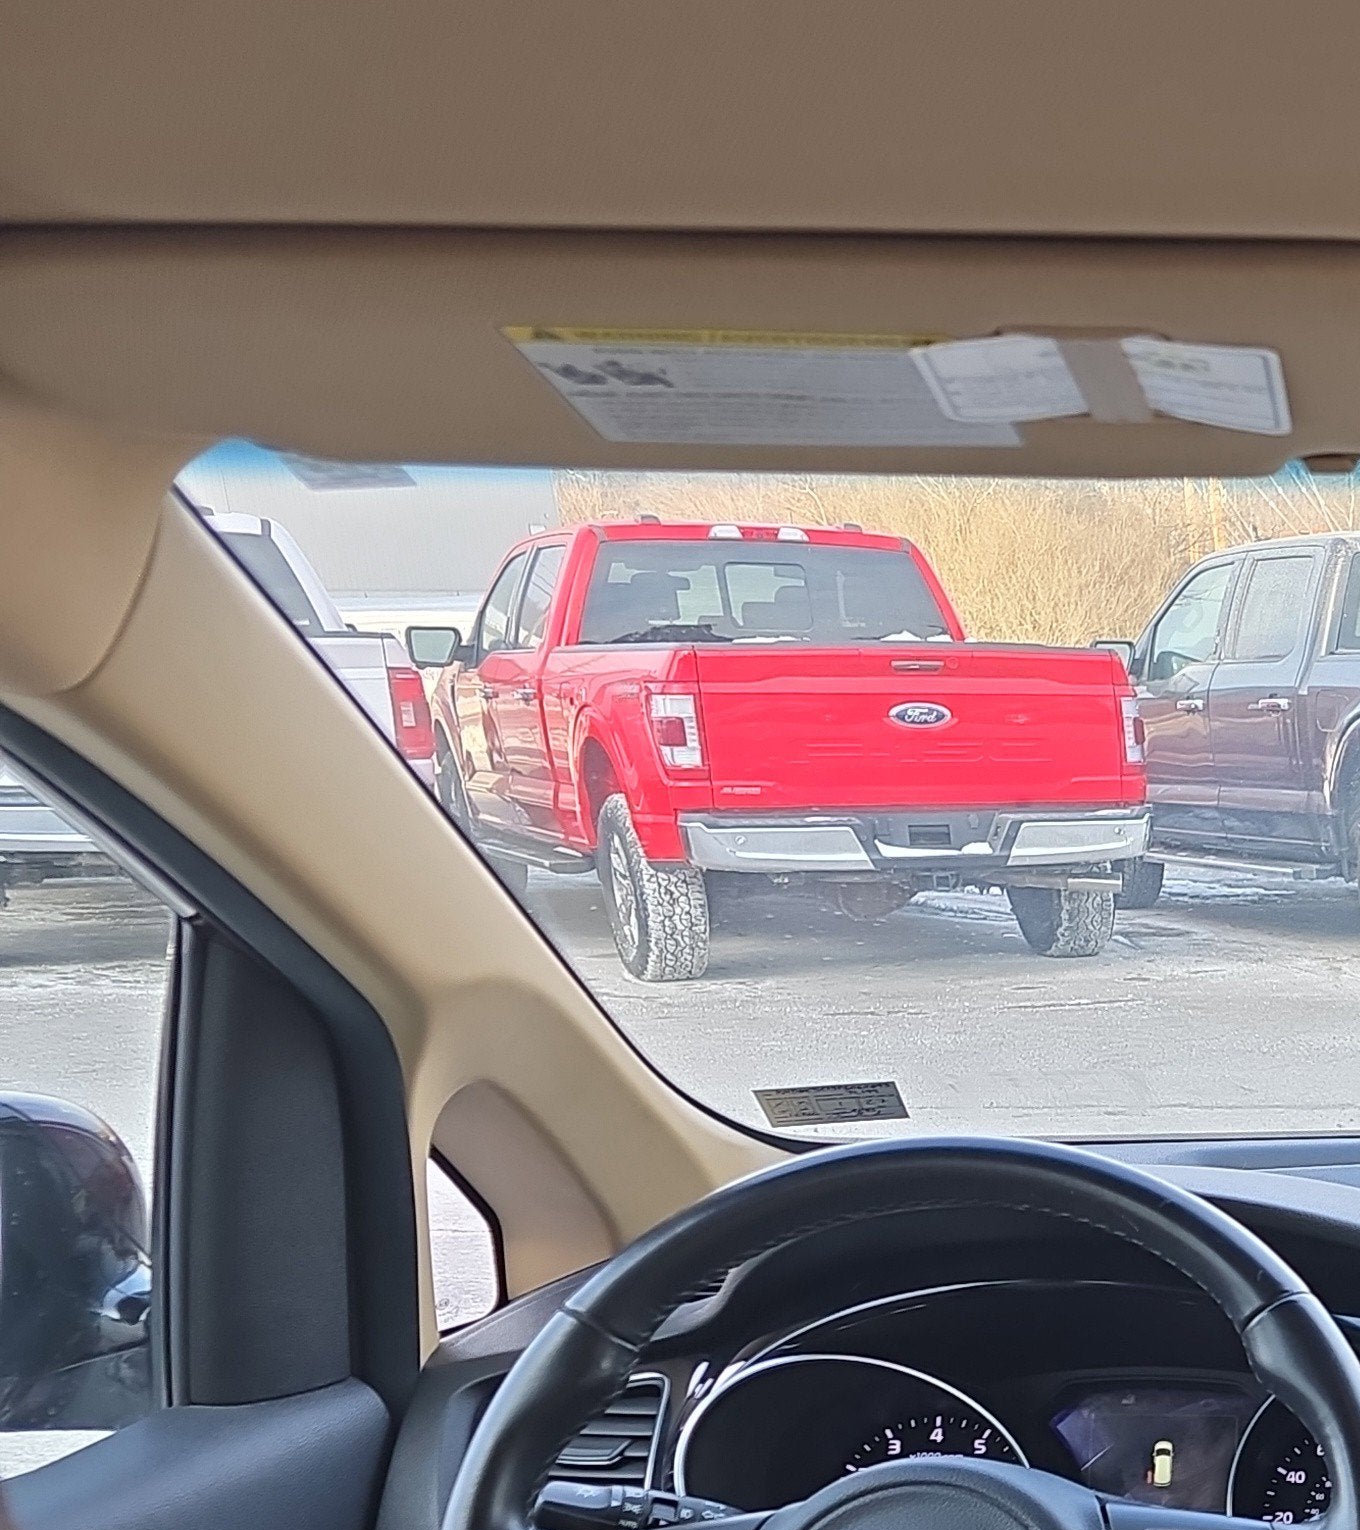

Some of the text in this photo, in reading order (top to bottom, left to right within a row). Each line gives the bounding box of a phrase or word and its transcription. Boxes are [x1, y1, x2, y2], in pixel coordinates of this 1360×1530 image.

[905, 707, 936, 723] Ford
[930, 1427, 944, 1442] 4
[887, 1439, 987, 1455] 3 5
[1286, 1471, 1306, 1484] 40
[1274, 1511, 1294, 1524] 20
